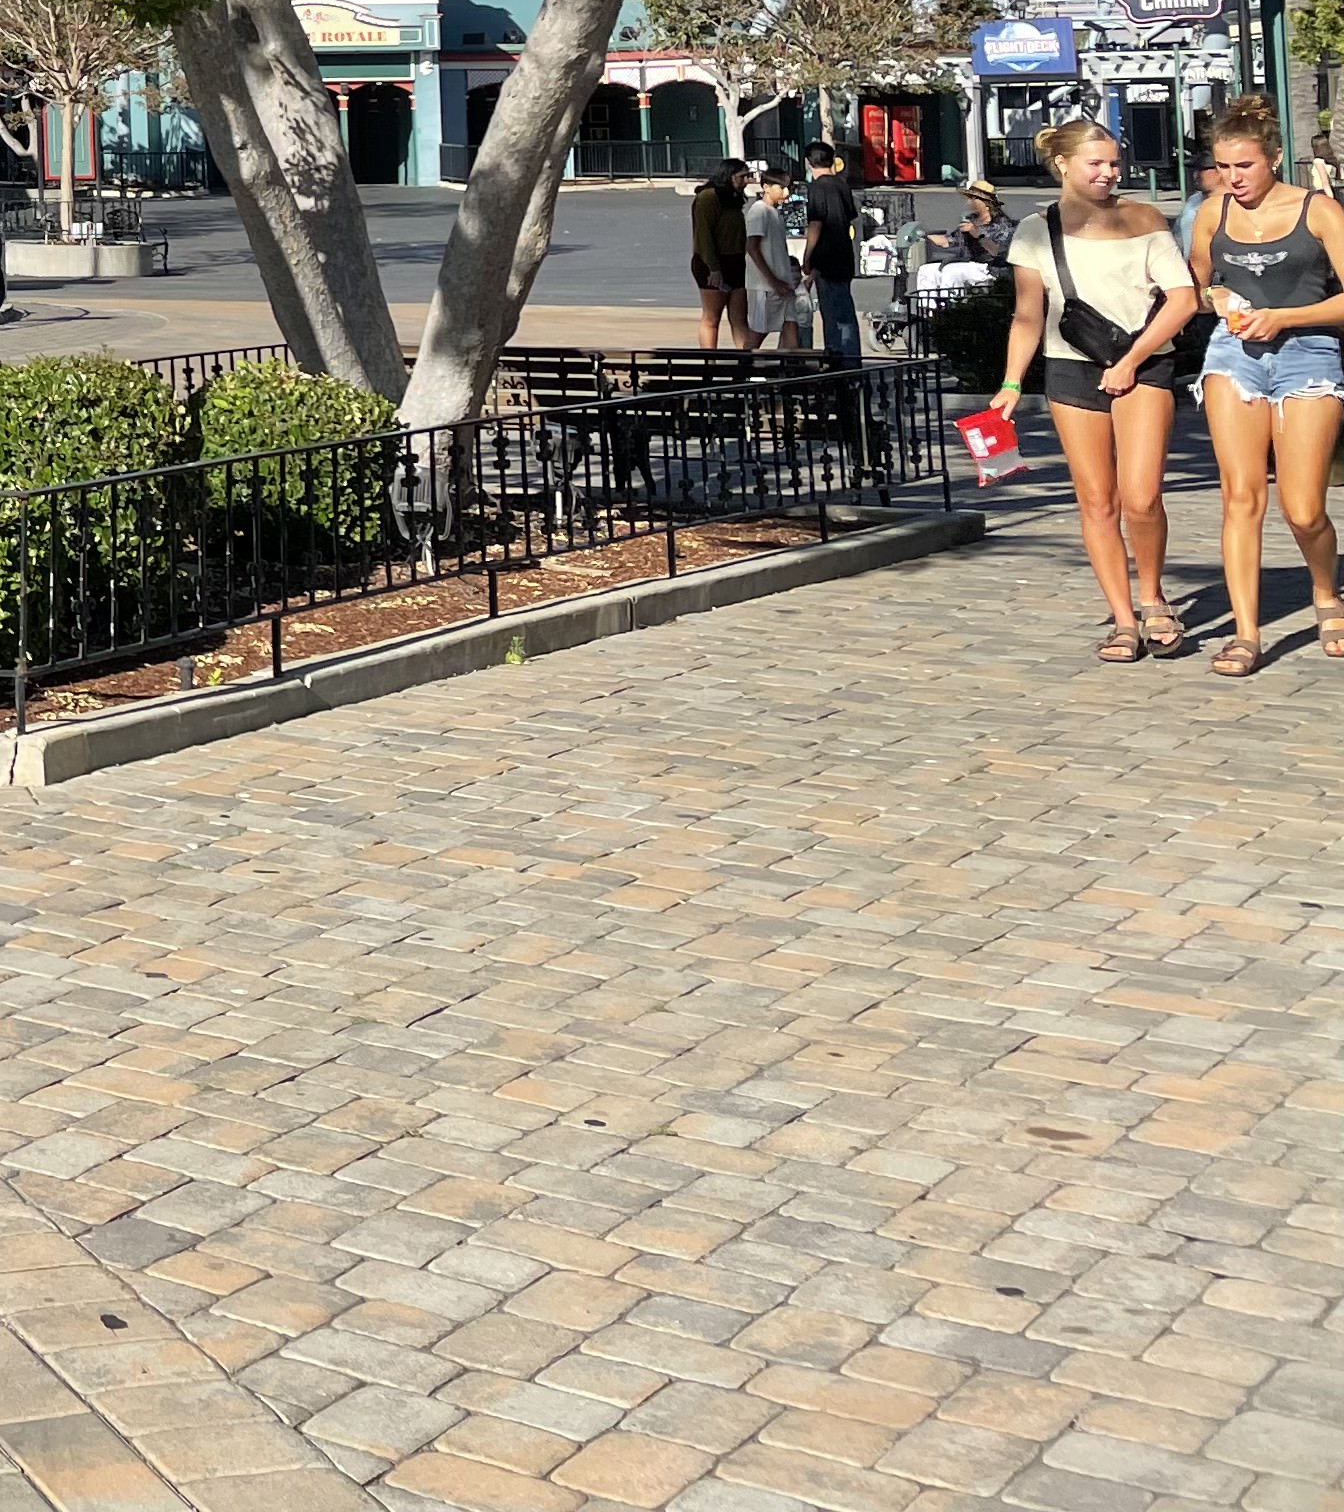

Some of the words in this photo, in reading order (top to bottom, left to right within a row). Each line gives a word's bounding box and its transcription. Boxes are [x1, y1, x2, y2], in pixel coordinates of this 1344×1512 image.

[321, 31, 387, 42] ROYALE
[986, 39, 1025, 54] FLIGHT
[1026, 38, 1057, 54] DECK
